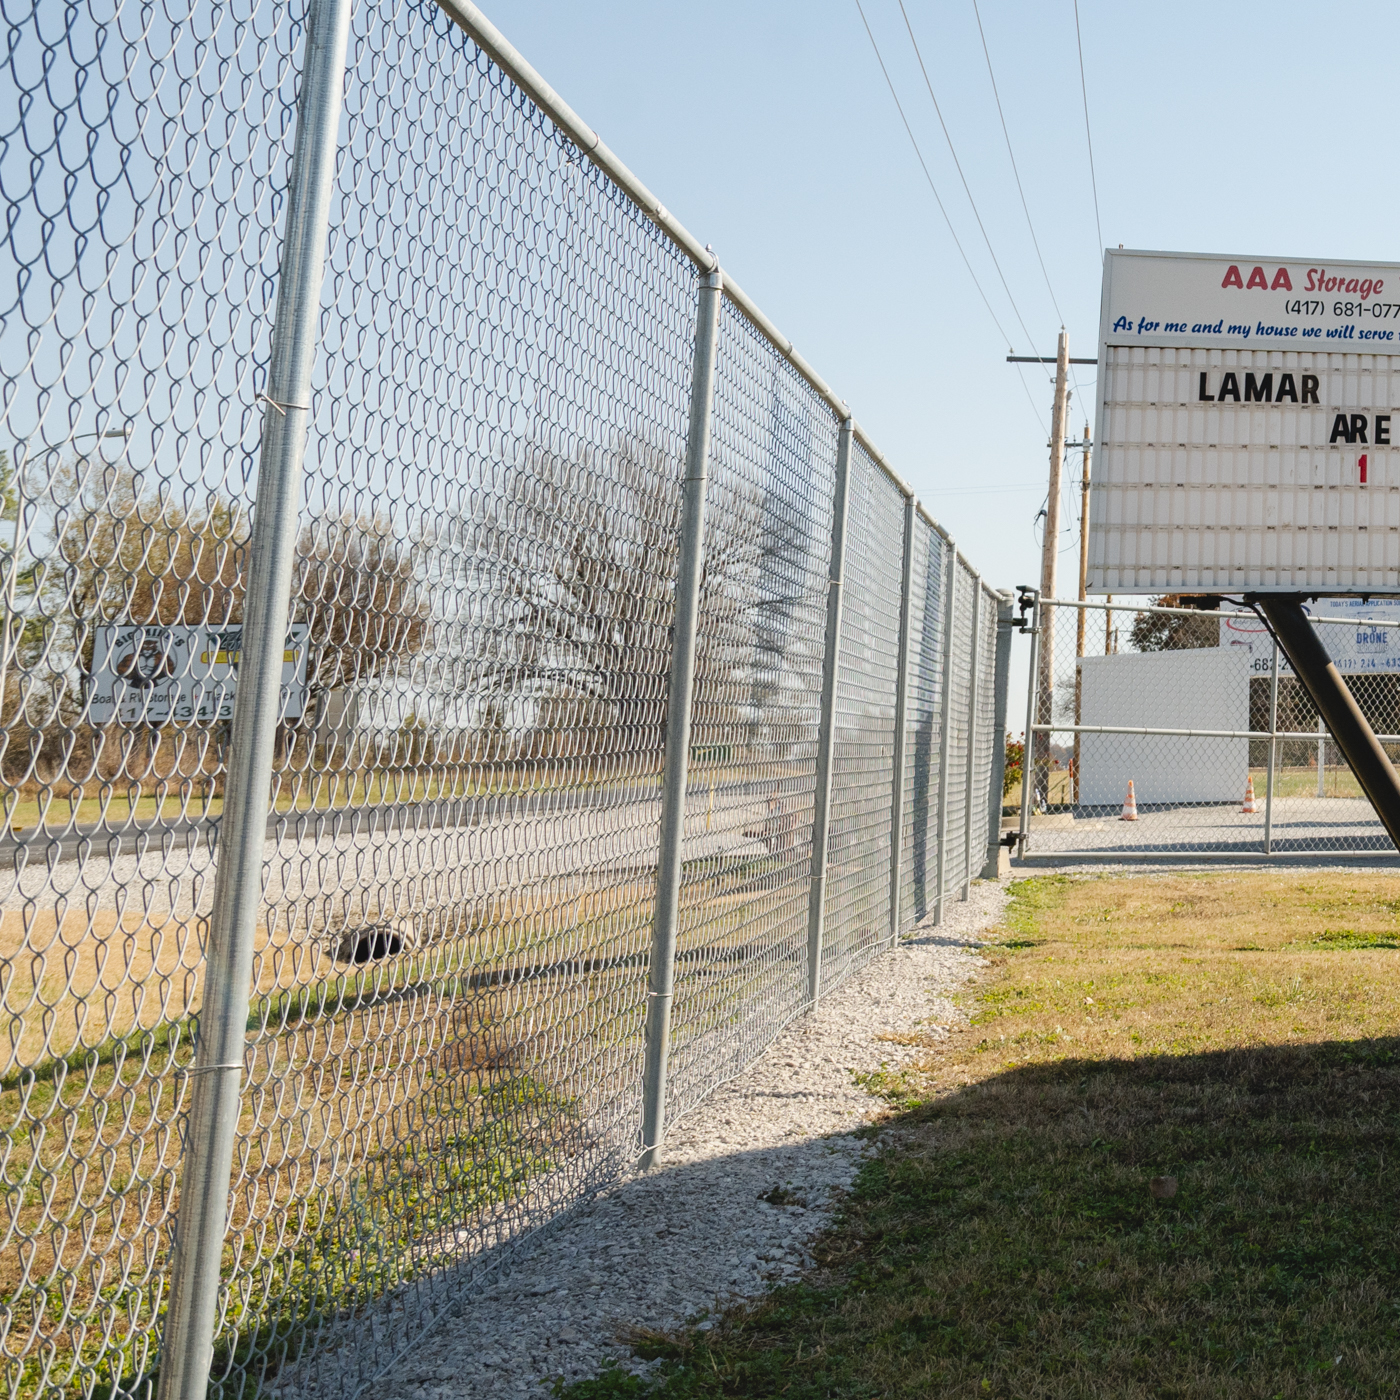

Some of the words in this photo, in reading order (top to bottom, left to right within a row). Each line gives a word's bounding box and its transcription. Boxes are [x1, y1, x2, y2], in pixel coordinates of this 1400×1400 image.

[1221, 265, 1293, 291] AAA
[1304, 268, 1384, 301] Storage
[1285, 299, 1325, 316] (417)
[1113, 316, 1133, 333] As
[1138, 317, 1160, 335] for
[1164, 322, 1187, 333] me
[1192, 320, 1224, 334] and
[1228, 324, 1251, 338] my
[1256, 321, 1298, 337] house
[1302, 327, 1322, 338] we
[1326, 325, 1355, 339] will
[1358, 328, 1394, 341] serve
[1199, 371, 1320, 404] LAMAR
[1329, 414, 1391, 444] ARE
[1358, 454, 1368, 483] 1
[1356, 632, 1388, 644] DRONE
[92, 693, 116, 704] Boa
